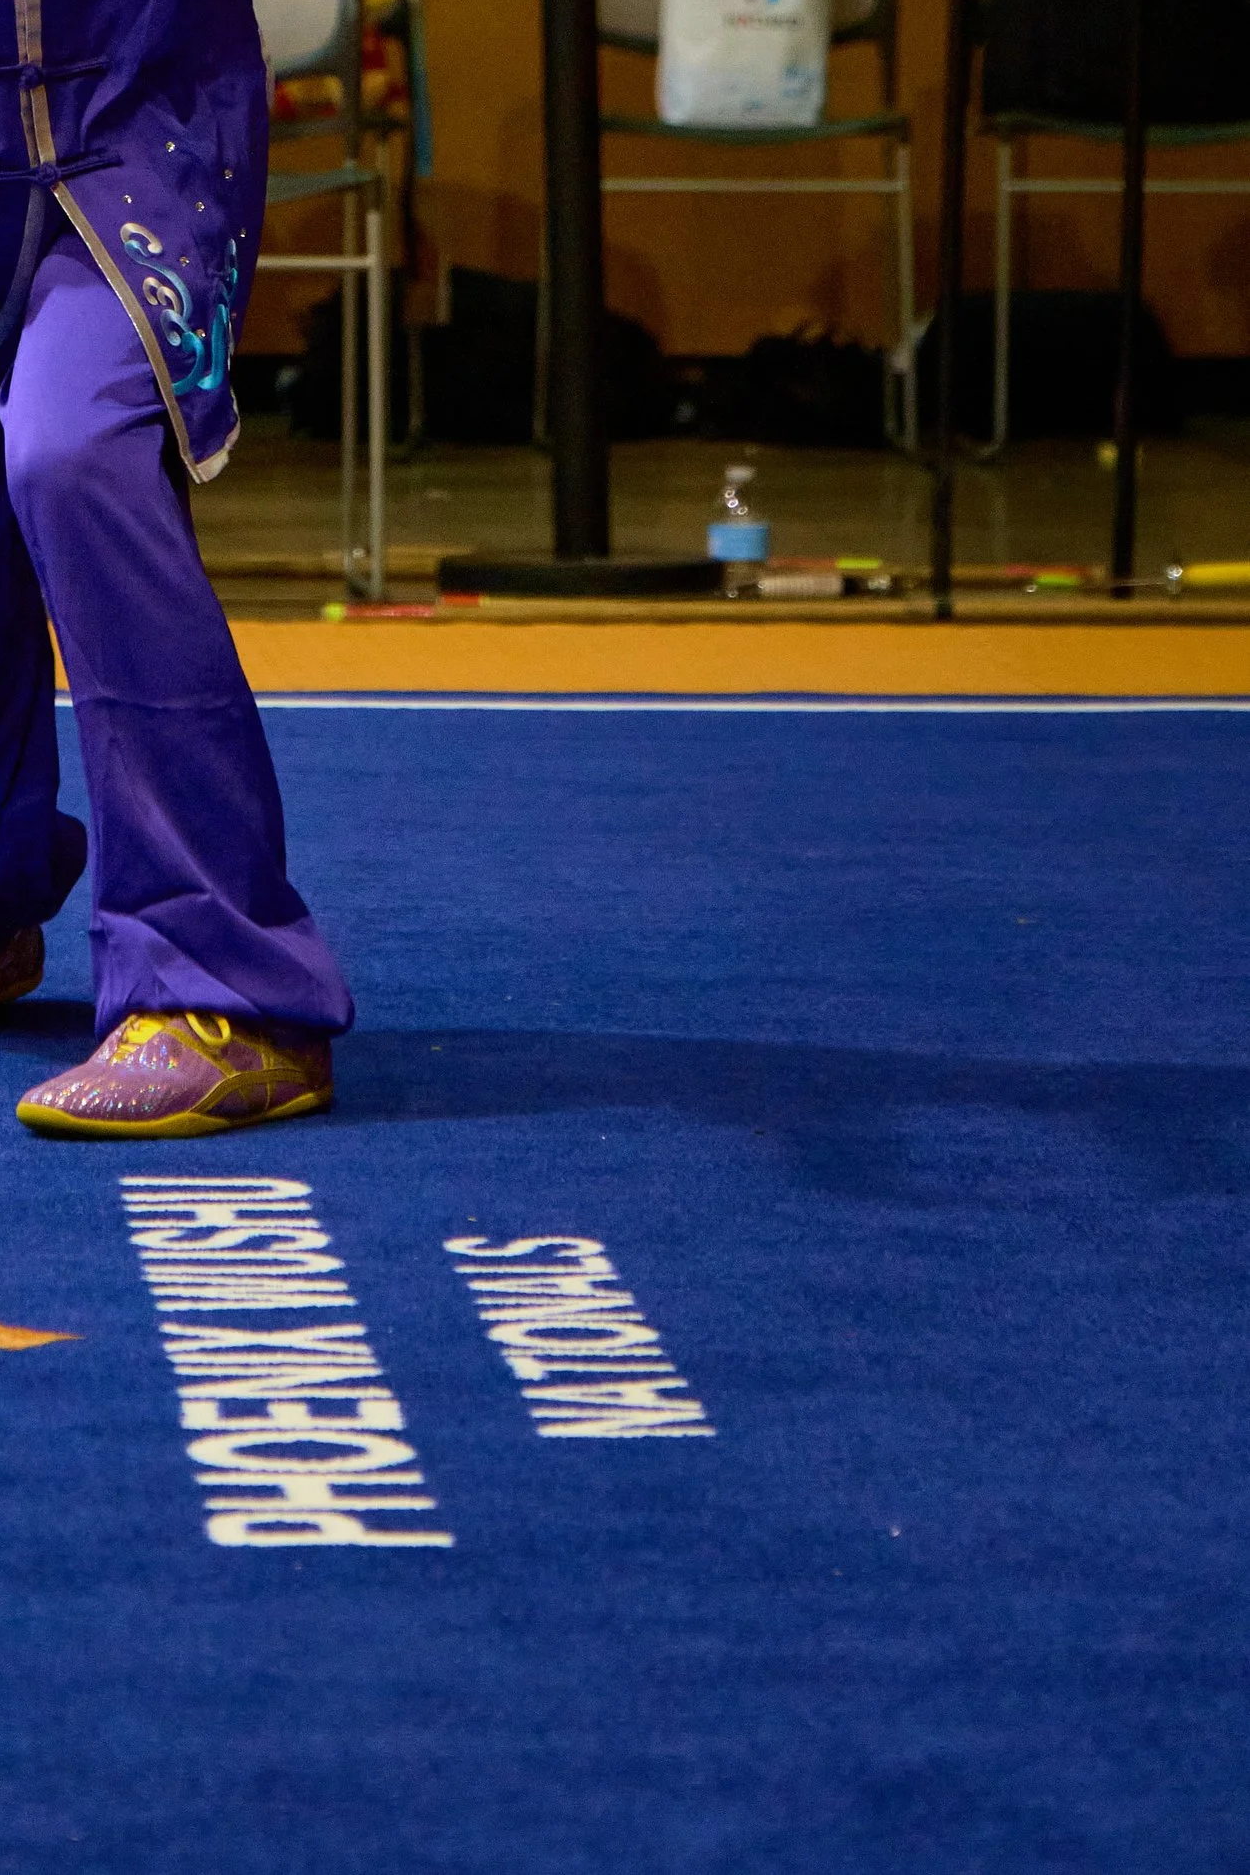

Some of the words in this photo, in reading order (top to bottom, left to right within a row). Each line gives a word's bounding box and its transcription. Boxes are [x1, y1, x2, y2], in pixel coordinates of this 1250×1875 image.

[118, 1175, 358, 1313] WUSHU
[442, 1235, 717, 1440] NATIONALS
[158, 1321, 455, 1548] PHOENIX
